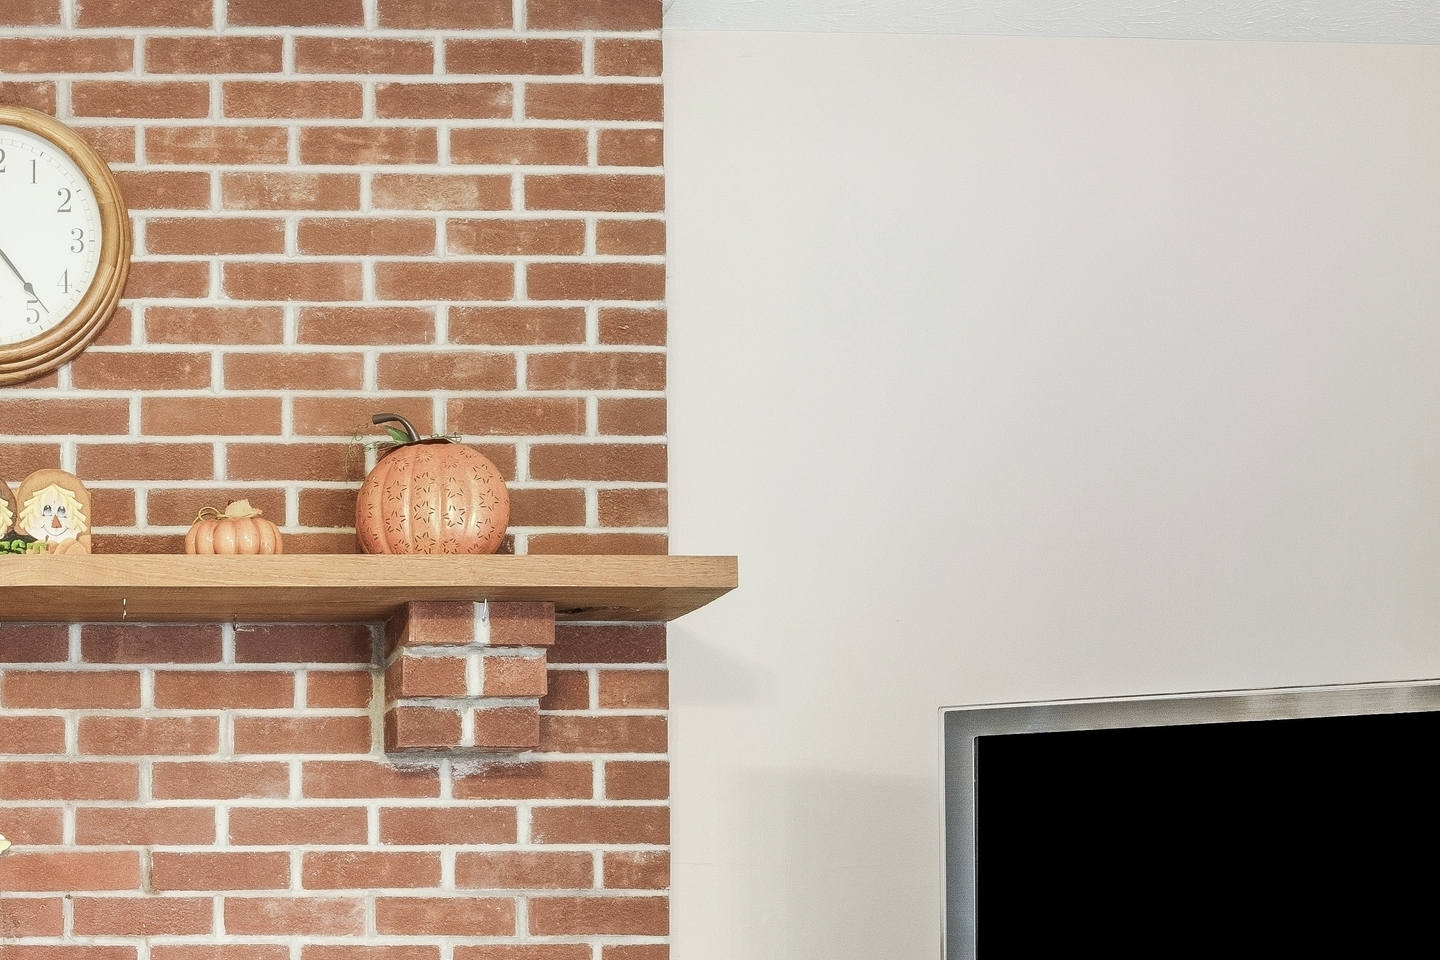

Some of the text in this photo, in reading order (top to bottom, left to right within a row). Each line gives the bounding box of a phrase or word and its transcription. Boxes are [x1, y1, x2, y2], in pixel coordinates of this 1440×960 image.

[30, 159, 38, 184] 1
[57, 188, 72, 212] 2
[70, 228, 84, 253] 3
[57, 268, 72, 294] 4
[26, 300, 40, 324] 5
